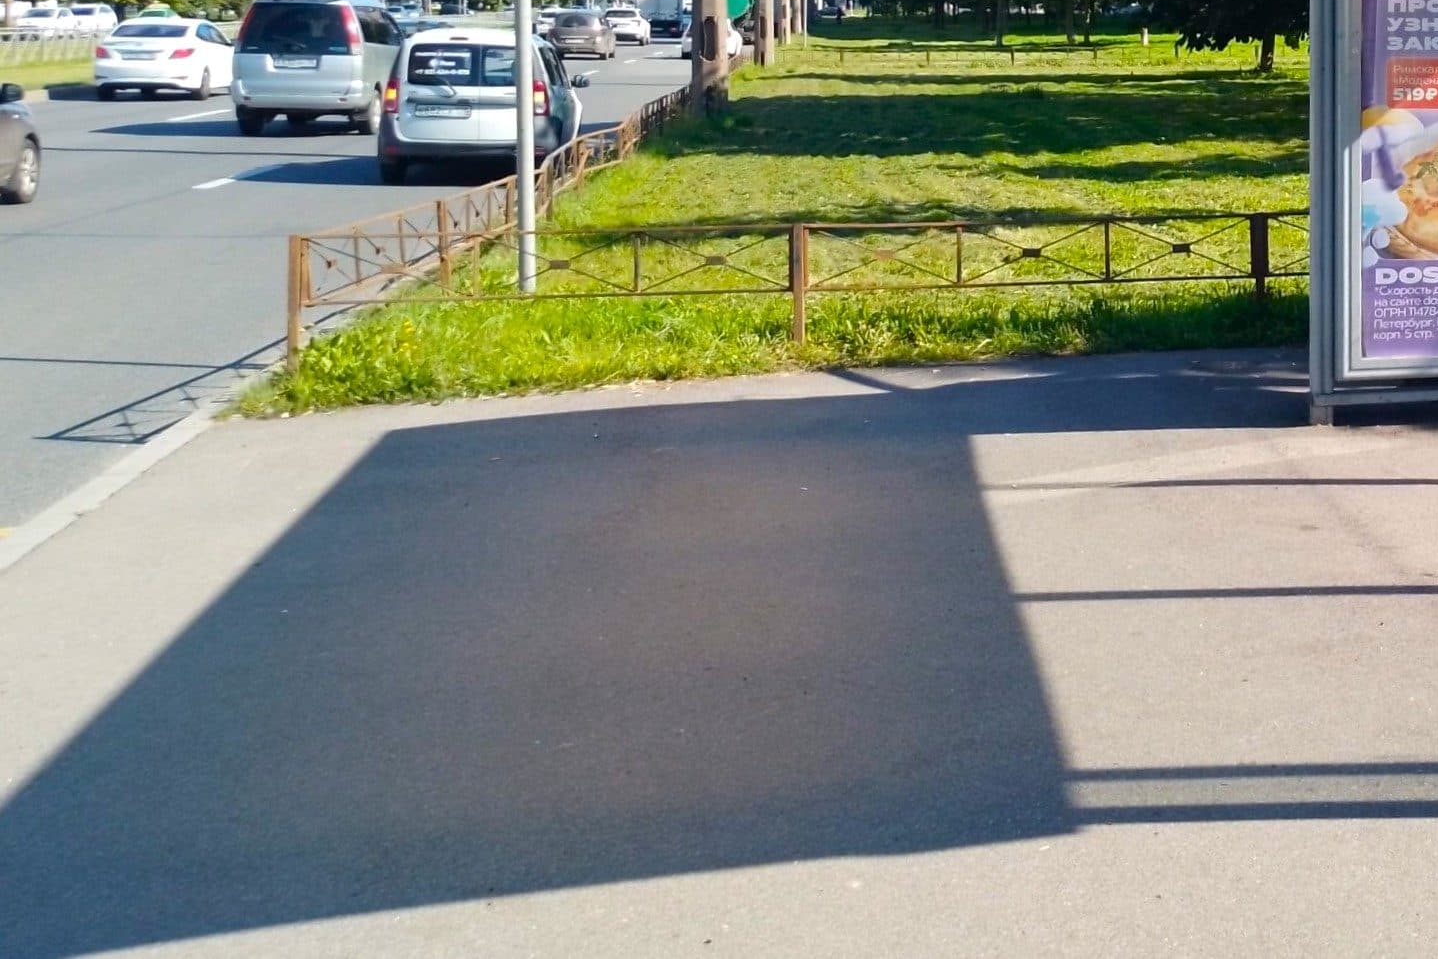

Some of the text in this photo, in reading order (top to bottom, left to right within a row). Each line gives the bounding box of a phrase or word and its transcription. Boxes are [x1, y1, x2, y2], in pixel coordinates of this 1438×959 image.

[1374, 299, 1388, 307] на
[1374, 306, 1407, 318] ОГРН
[1404, 328, 1413, 339] 5
